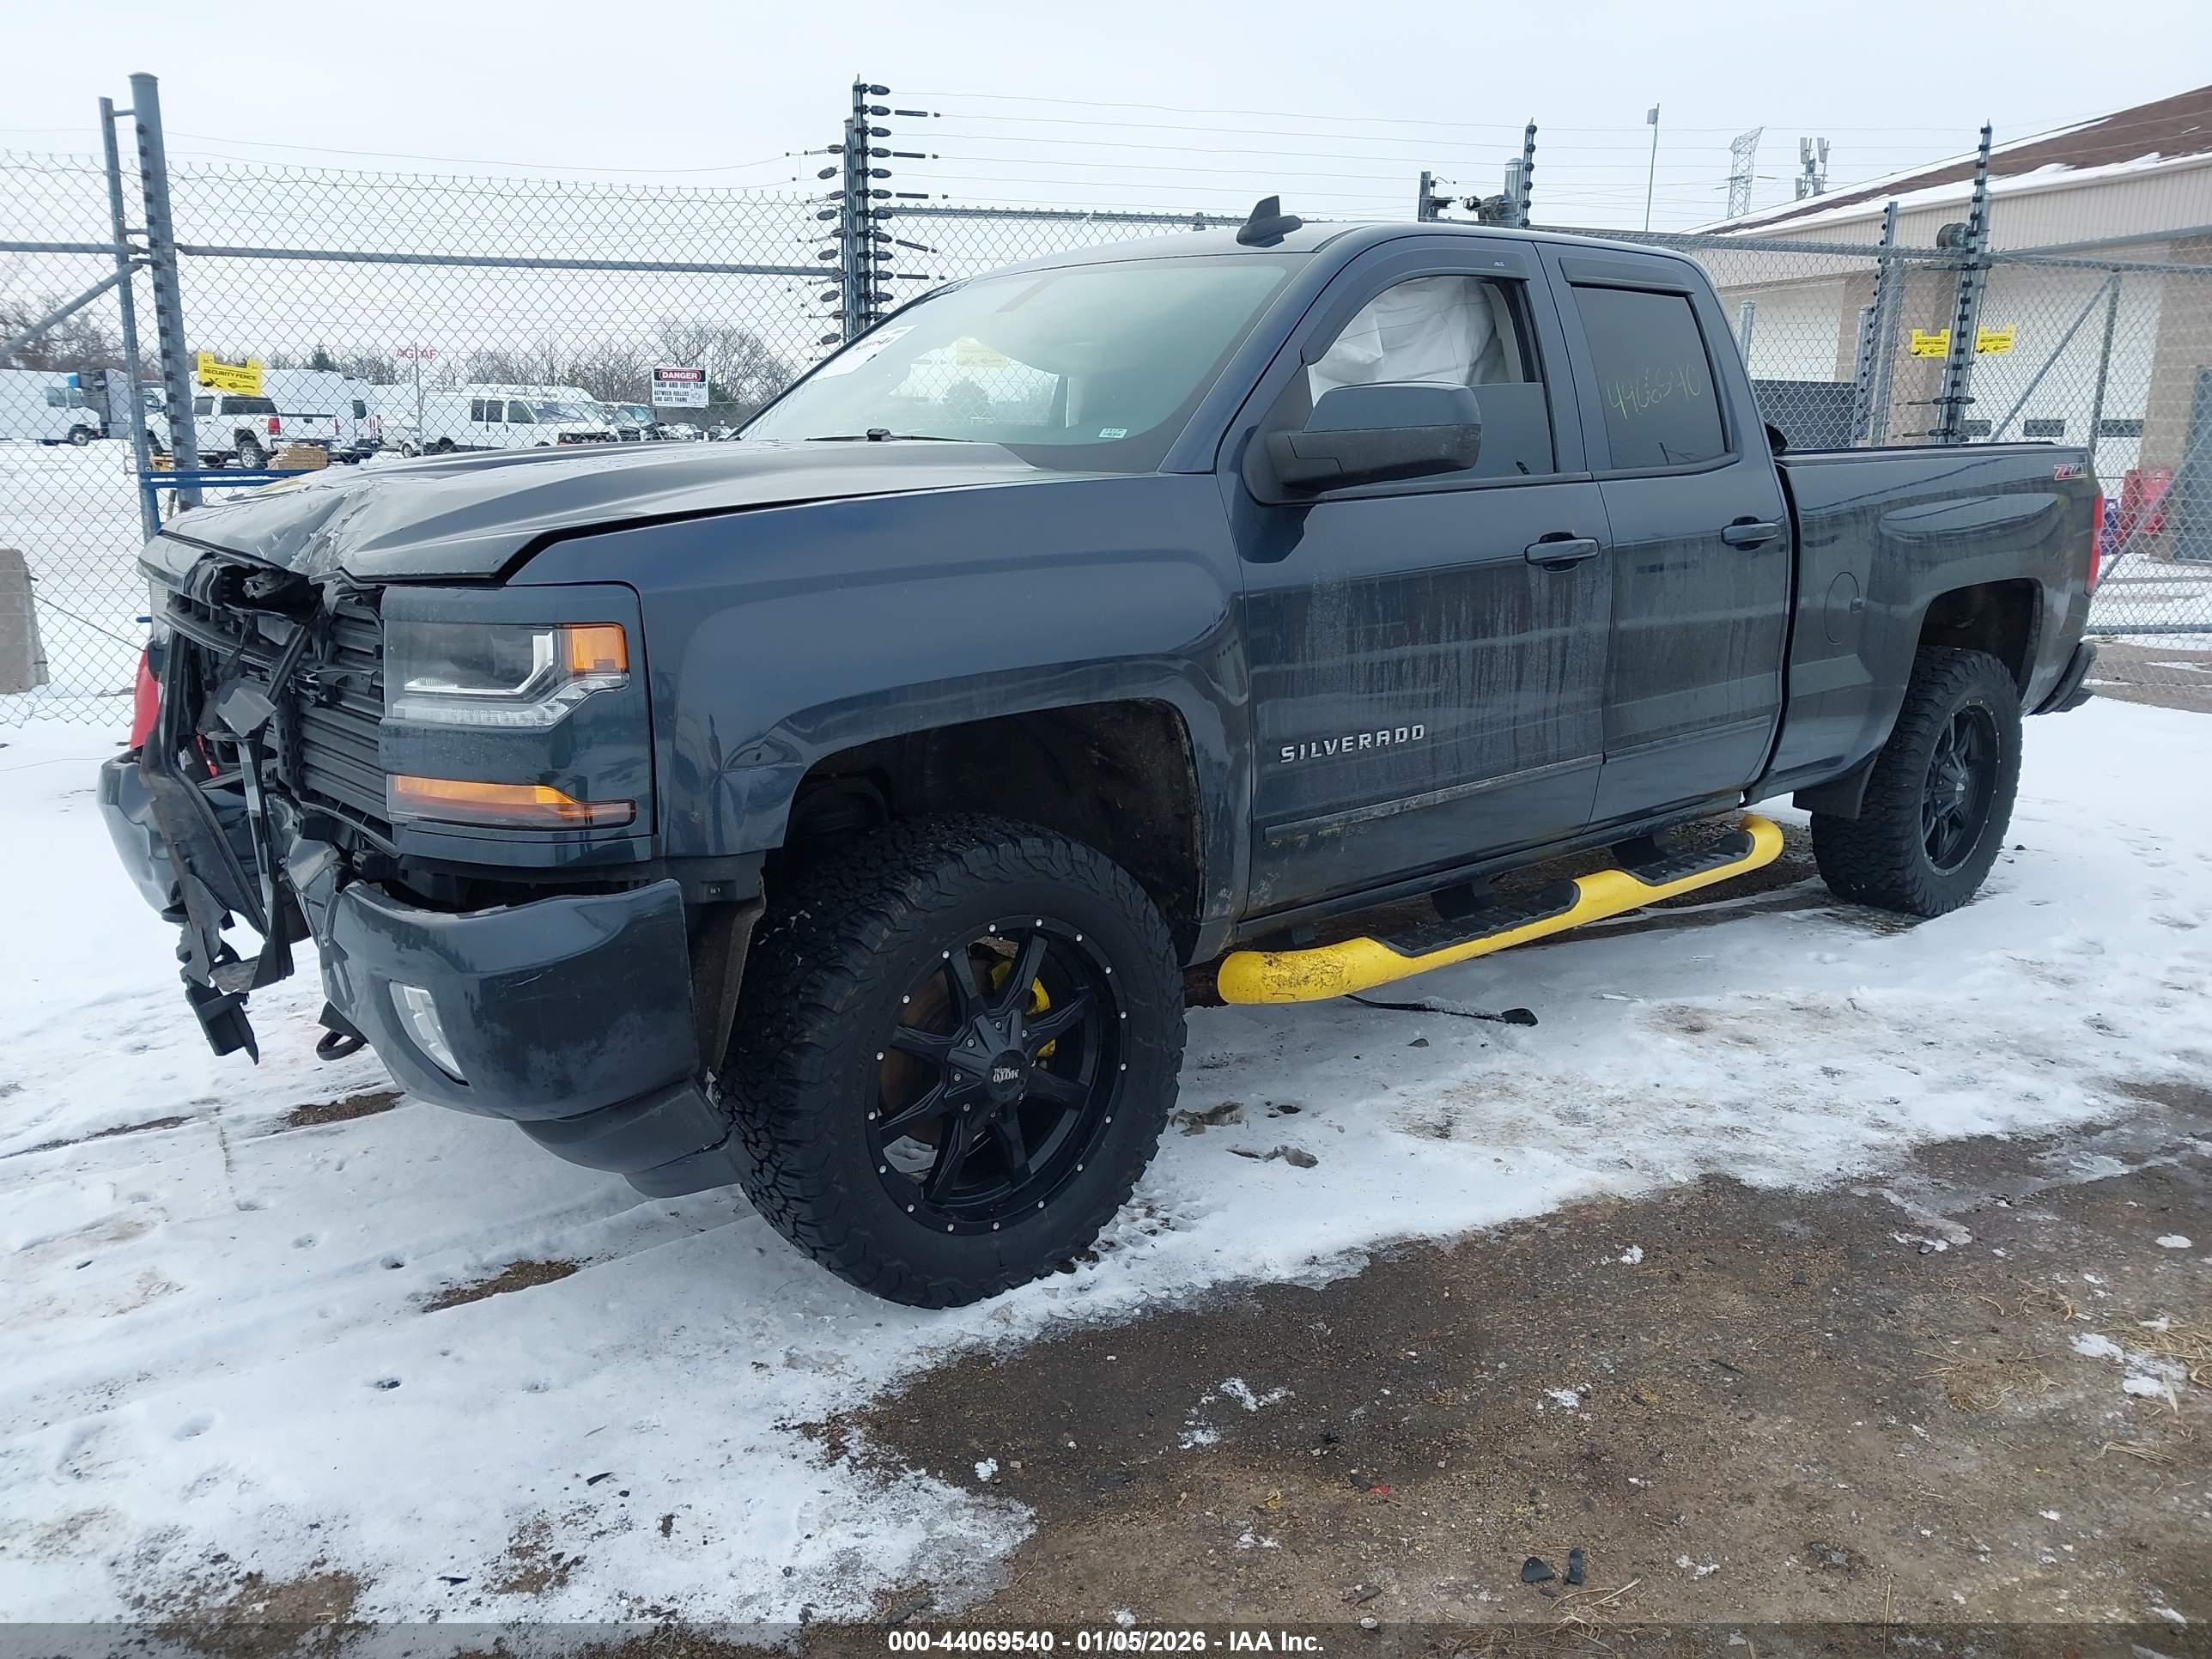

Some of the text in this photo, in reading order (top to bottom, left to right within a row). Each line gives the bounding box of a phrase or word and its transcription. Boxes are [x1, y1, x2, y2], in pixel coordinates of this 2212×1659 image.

[204, 368, 258, 381] SECURITY FENCE
[2053, 463, 2088, 481] Z71
[1280, 724, 1425, 763] SILVERADO
